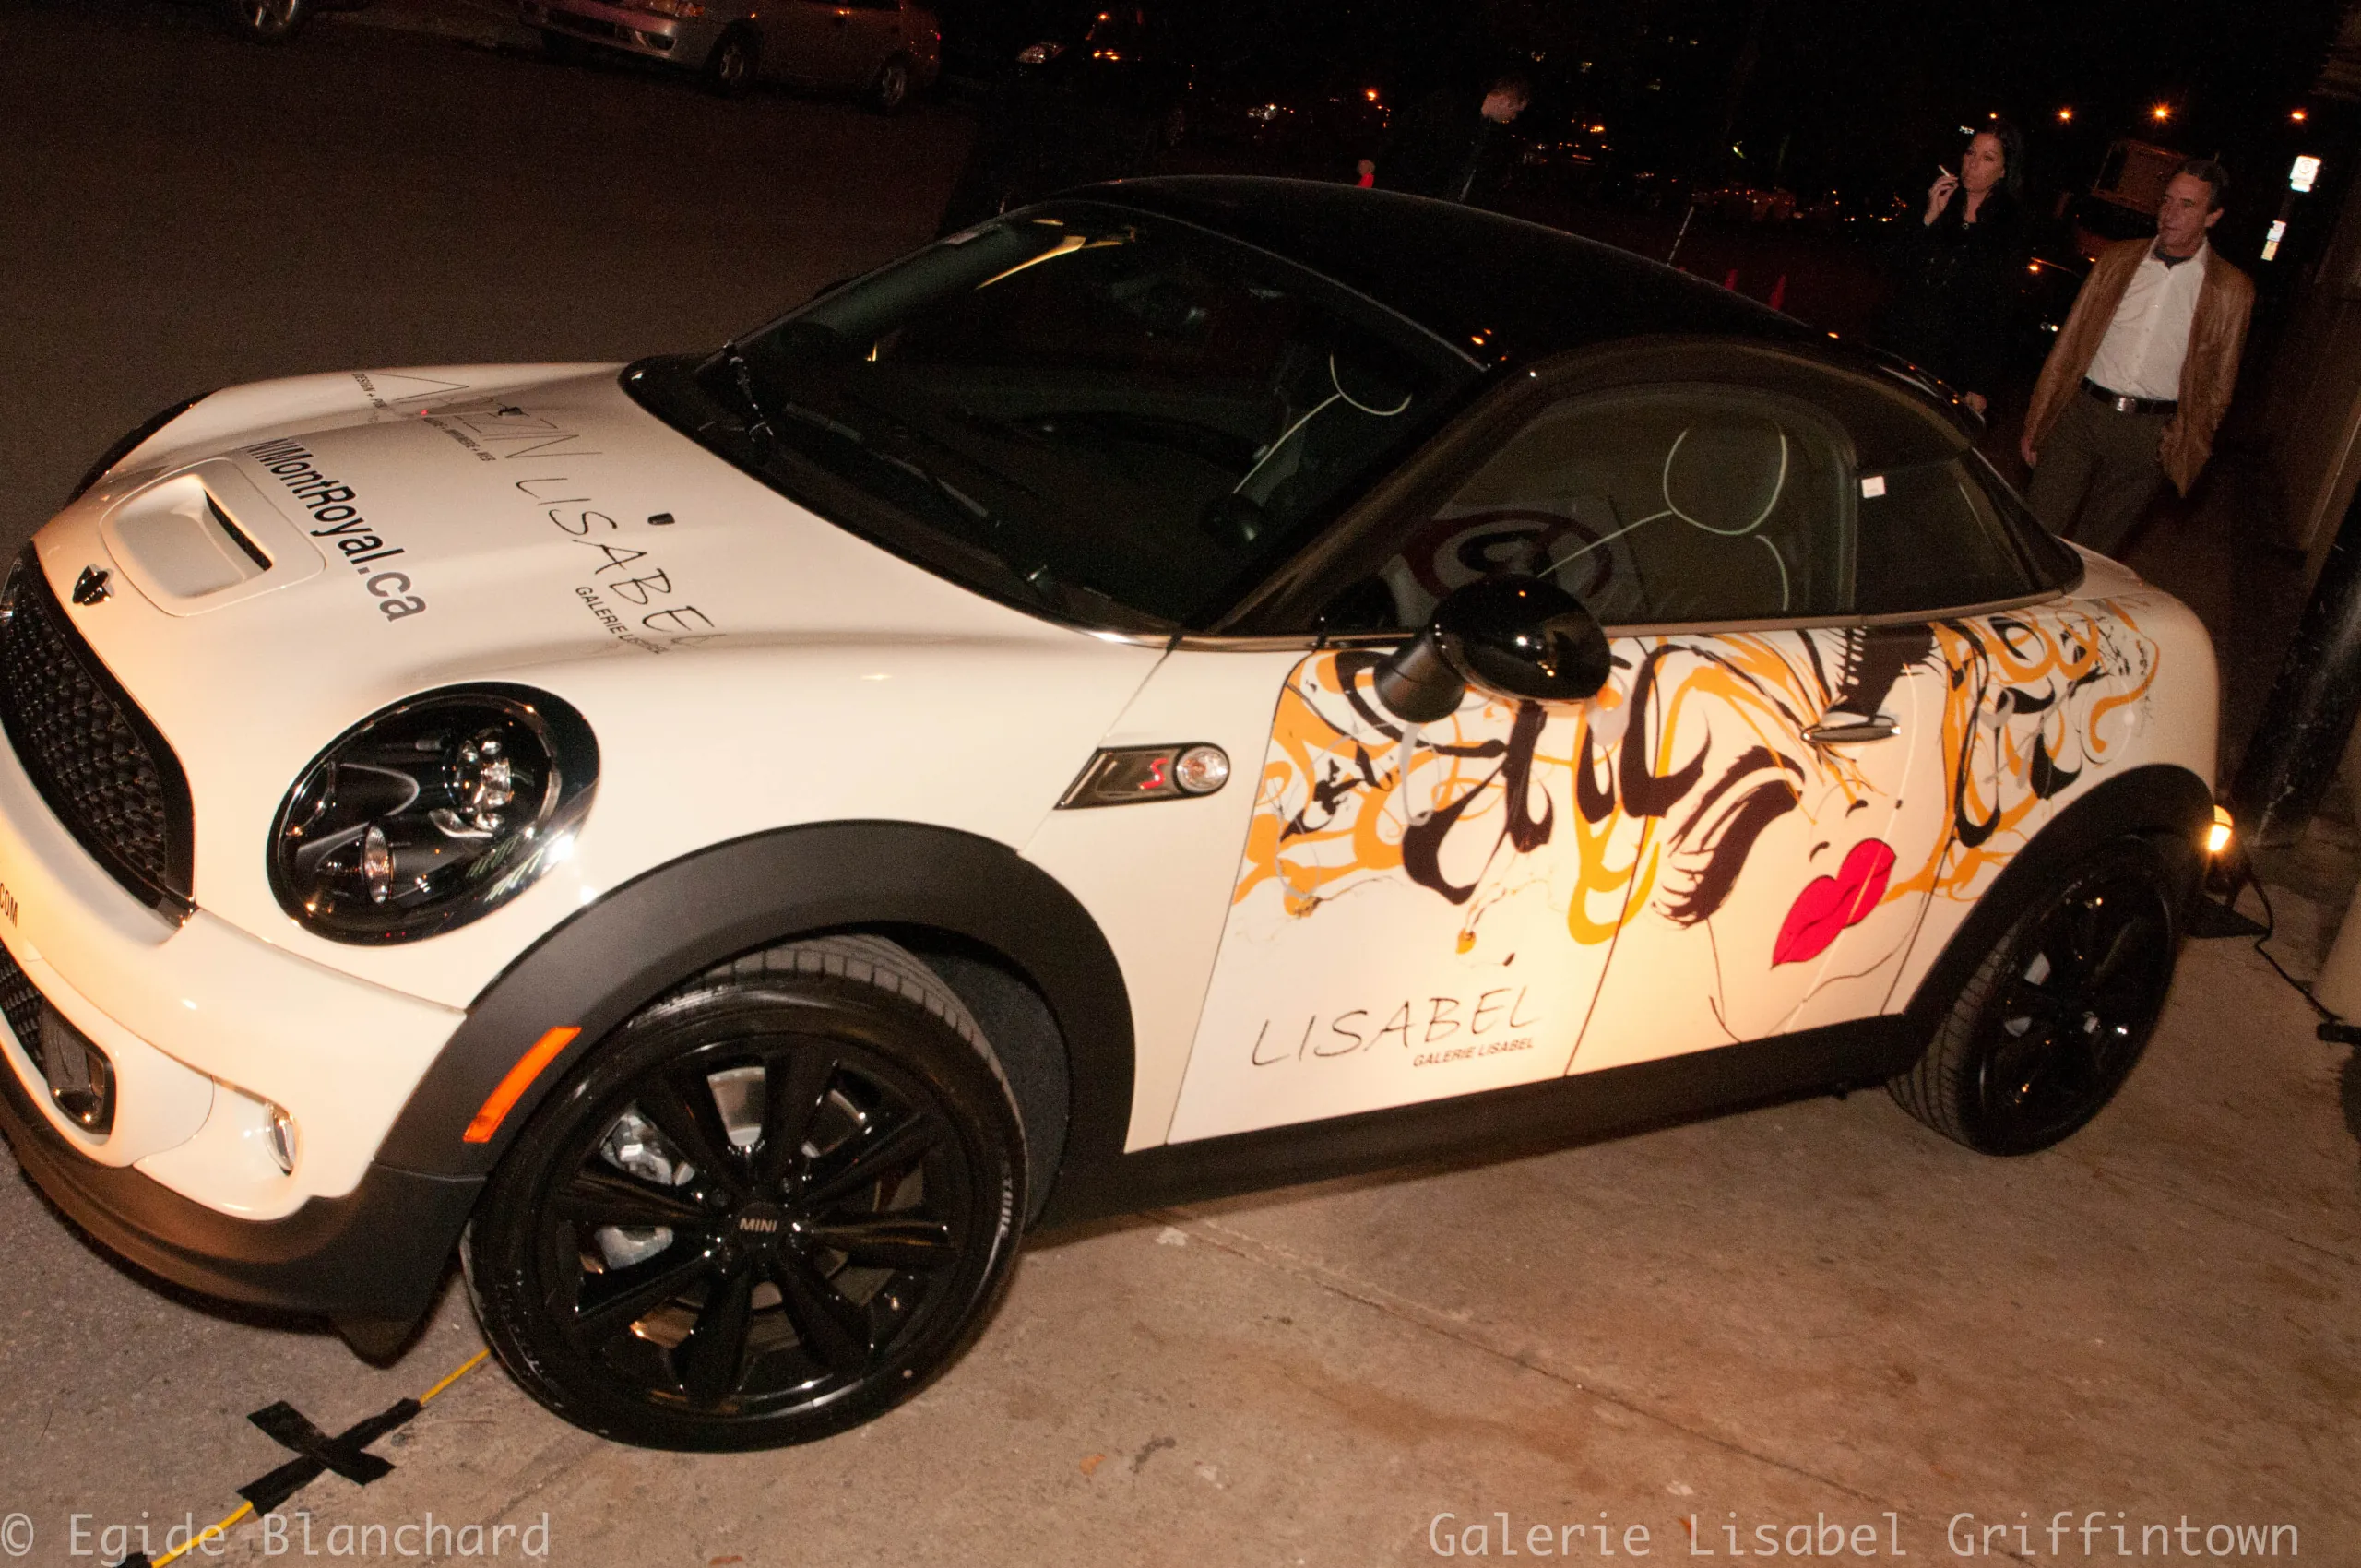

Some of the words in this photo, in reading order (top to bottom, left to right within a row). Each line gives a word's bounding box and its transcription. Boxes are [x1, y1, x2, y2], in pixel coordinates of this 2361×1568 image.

[515, 477, 727, 648] LISABEL
[575, 586, 629, 635] GALERIE
[1252, 984, 1541, 1066] LISABEL
[1413, 1046, 1476, 1067] GALERIE
[1477, 1038, 1533, 1057] LISABEL
[740, 1217, 778, 1233] MINI
